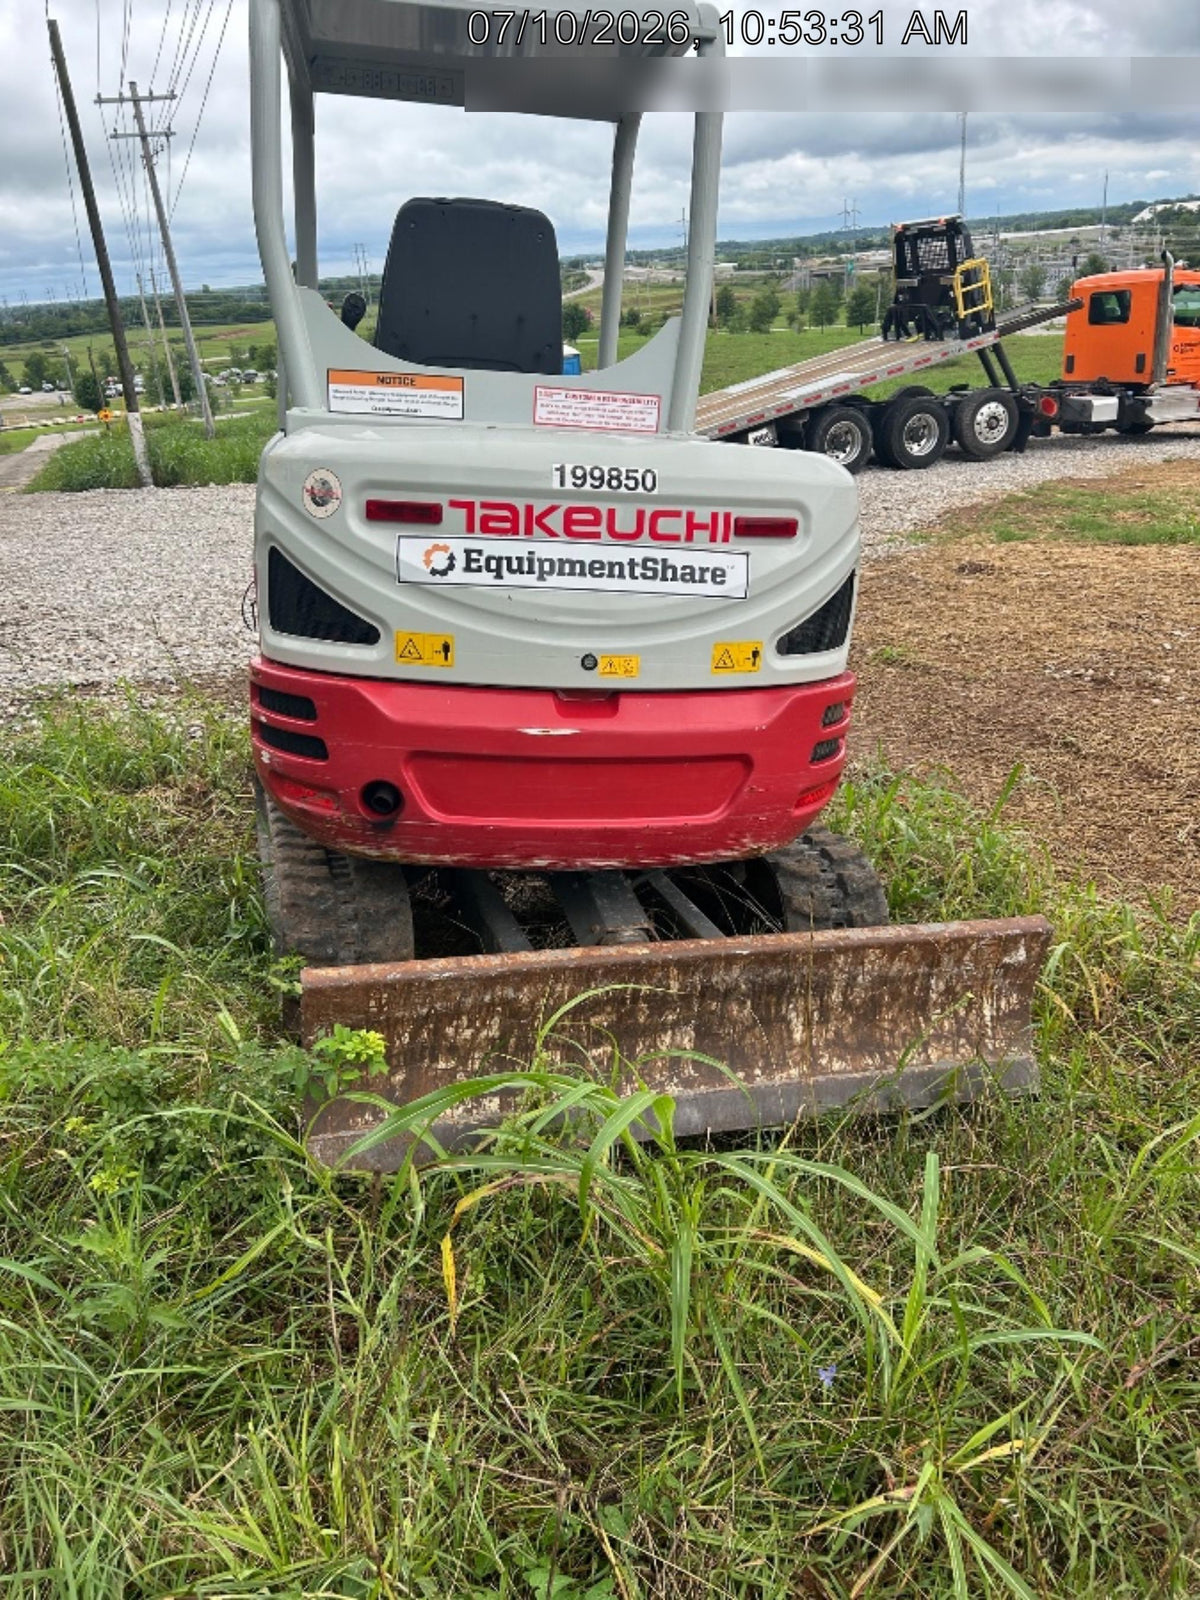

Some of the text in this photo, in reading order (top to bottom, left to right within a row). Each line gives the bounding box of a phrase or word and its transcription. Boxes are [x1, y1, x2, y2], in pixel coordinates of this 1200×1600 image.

[376, 376, 416, 386] NOTICE
[554, 464, 657, 492] 199850
[463, 549, 727, 585] EquipmentShare
